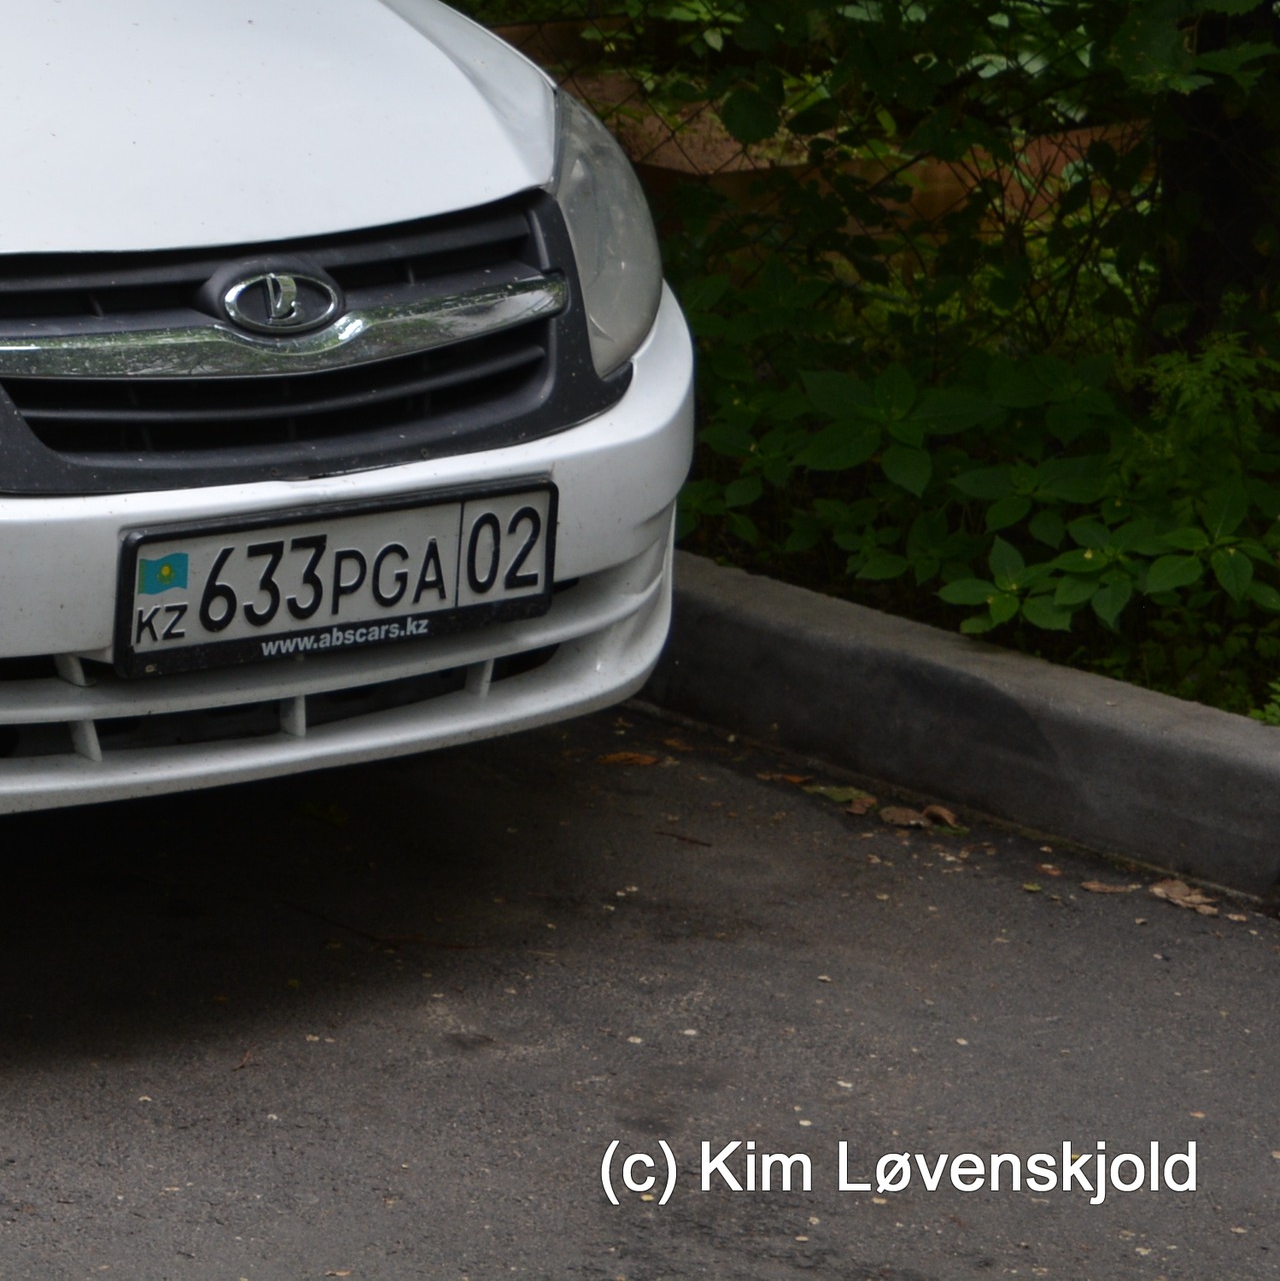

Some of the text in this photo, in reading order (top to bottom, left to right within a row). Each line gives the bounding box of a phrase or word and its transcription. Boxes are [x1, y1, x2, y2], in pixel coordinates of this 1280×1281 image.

[136, 506, 541, 643] KZ 633PGA 02
[261, 617, 428, 656] www.abscars.kz
